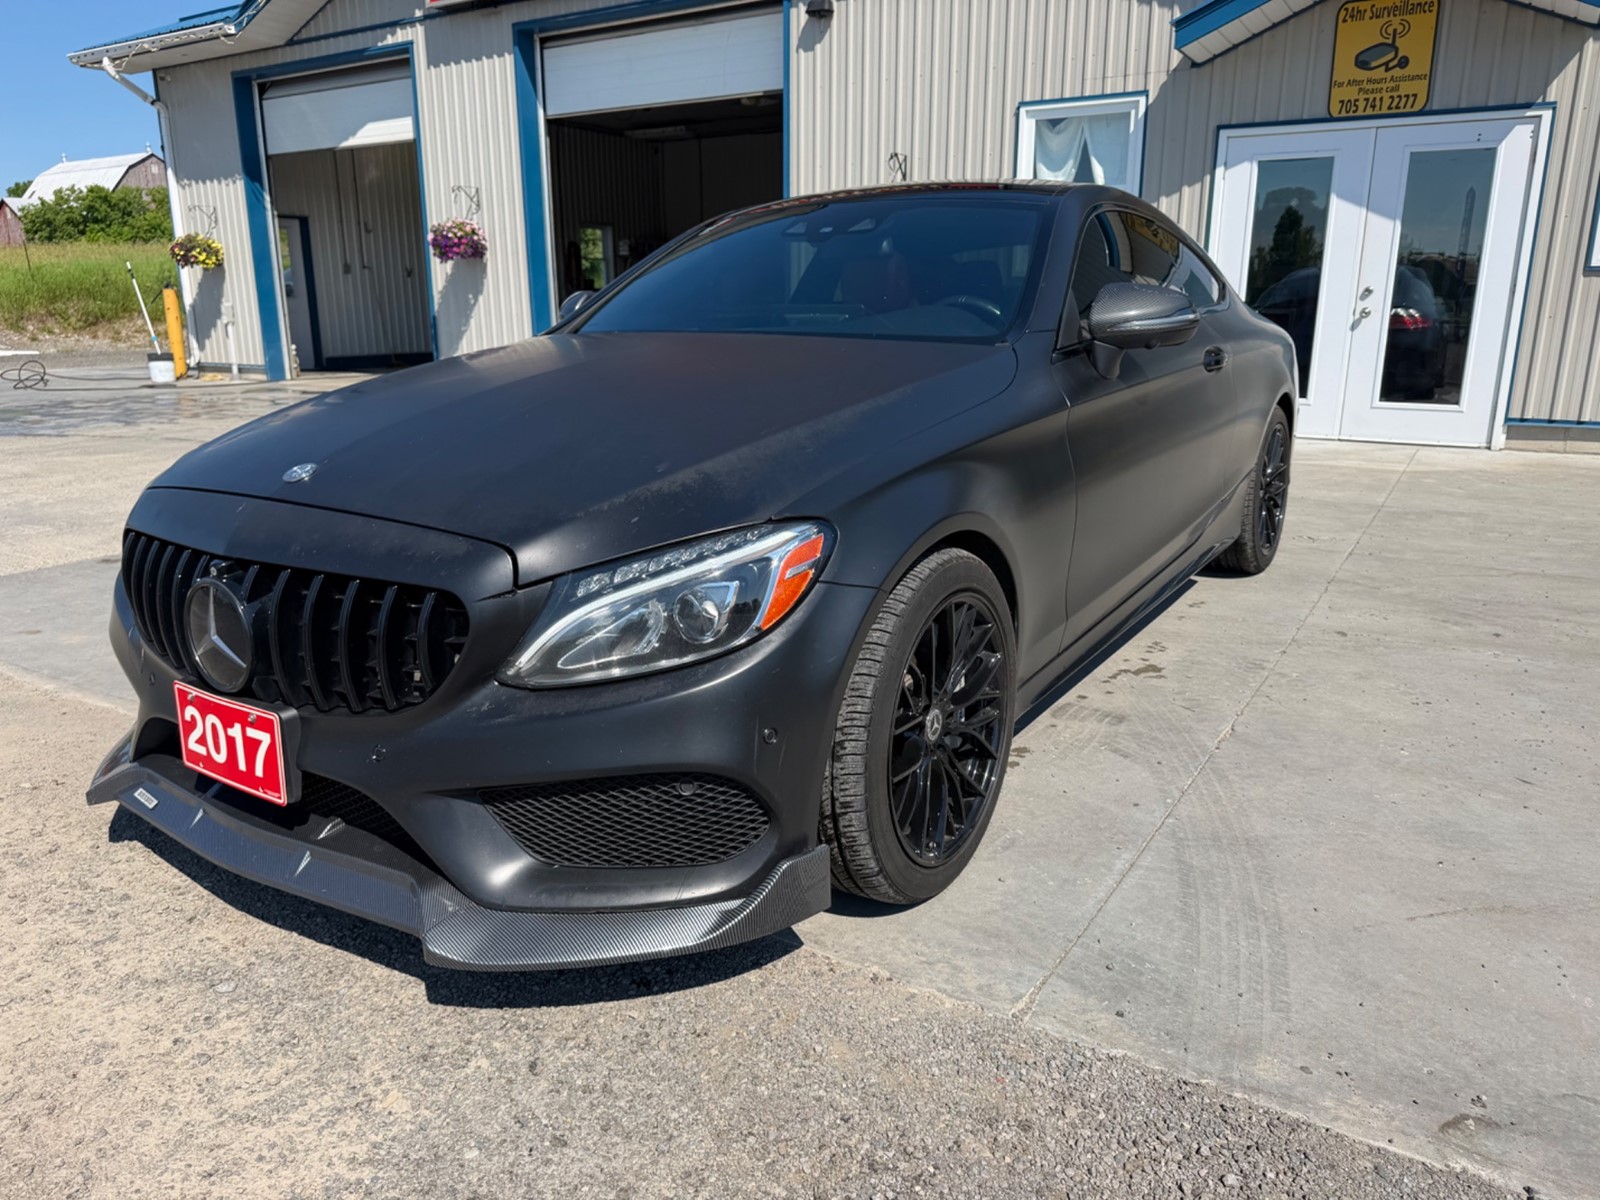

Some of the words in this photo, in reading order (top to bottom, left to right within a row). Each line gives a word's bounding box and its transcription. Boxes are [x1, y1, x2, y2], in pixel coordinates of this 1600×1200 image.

[1342, 6, 1367, 23] 24hr
[1369, 0, 1434, 20] Surveillance
[1333, 80, 1345, 88] For
[1346, 78, 1365, 87] After
[1366, 76, 1387, 85] Hours
[1389, 73, 1427, 83] Assistance
[1357, 87, 1383, 95] Please
[1385, 84, 1400, 93] call
[1338, 98, 1360, 115] 705
[1362, 96, 1384, 113] 741
[1387, 93, 1418, 111] 2277
[184, 705, 271, 778] 2017
